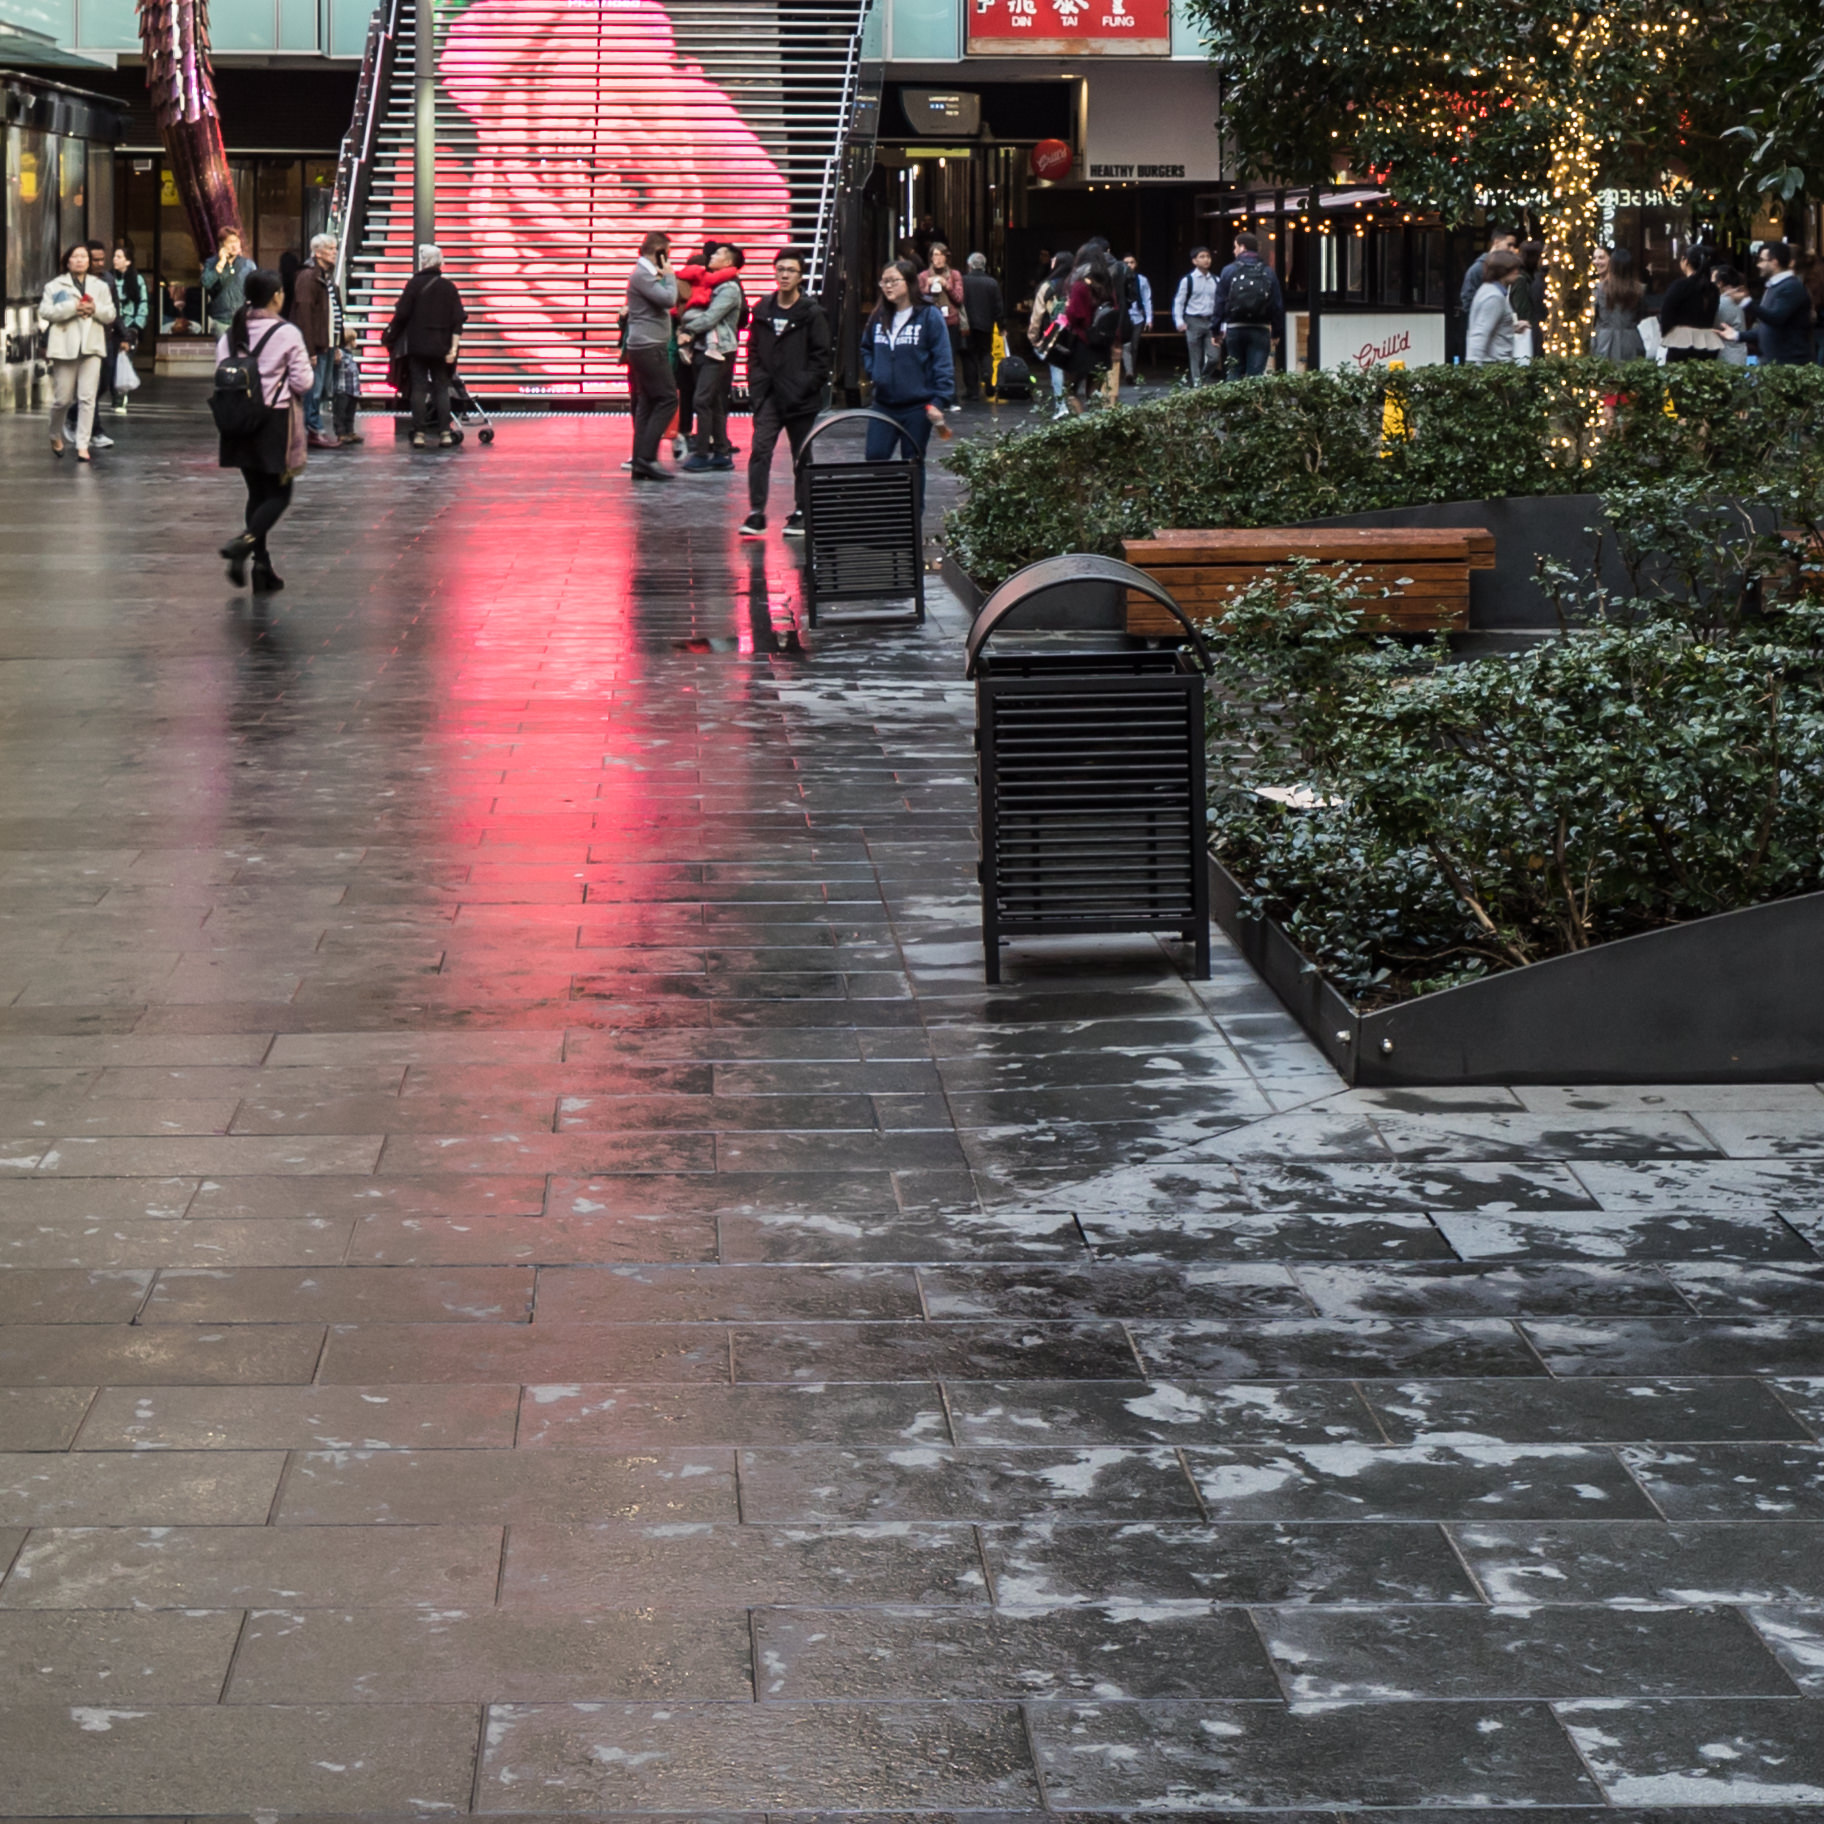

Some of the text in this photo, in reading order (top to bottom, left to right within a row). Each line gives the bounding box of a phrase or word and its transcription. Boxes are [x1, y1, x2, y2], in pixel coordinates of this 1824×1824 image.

[1011, 16, 1135, 28] DIN TAI FUNG
[1089, 163, 1186, 178] HEALTHY BURGERS
[1352, 330, 1411, 371] Grill'd
